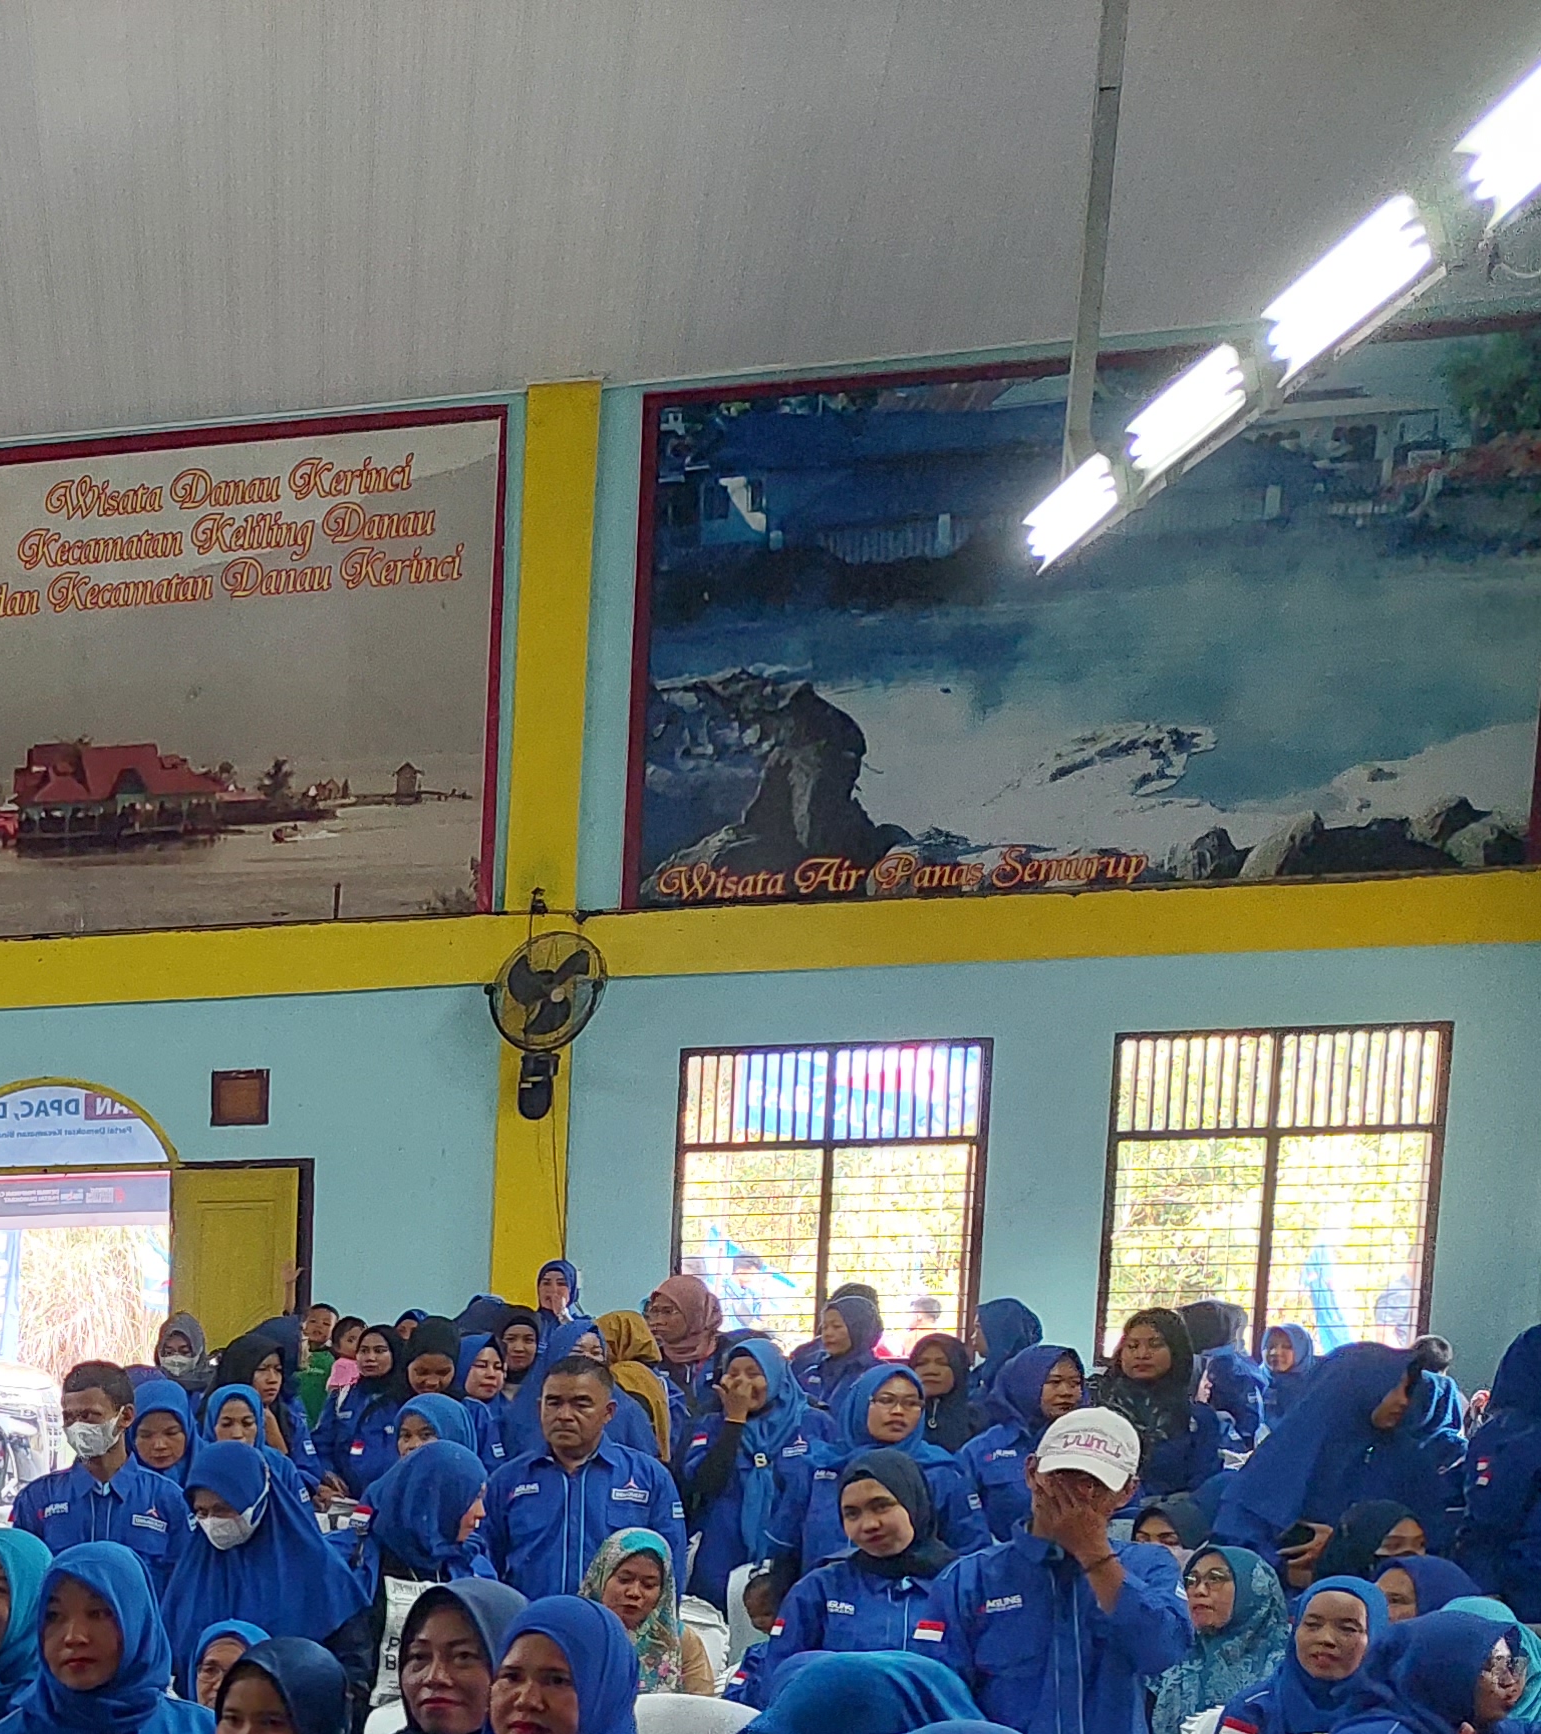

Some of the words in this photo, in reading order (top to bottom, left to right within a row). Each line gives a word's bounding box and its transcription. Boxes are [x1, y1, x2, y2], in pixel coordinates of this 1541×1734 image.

[44, 473, 163, 522] Wisata
[169, 466, 282, 510] Danau
[287, 452, 416, 499] Kerinci
[16, 527, 183, 571] Kecamatan
[189, 511, 316, 562] Keliling
[321, 500, 437, 543] Danau
[45, 569, 214, 613] Kecamatan
[219, 555, 332, 600] Danau
[338, 542, 465, 590] Kerinci
[656, 861, 786, 900] Wisata
[793, 855, 866, 895] Air
[873, 852, 984, 891] Panas
[991, 845, 1149, 889] Semurup
